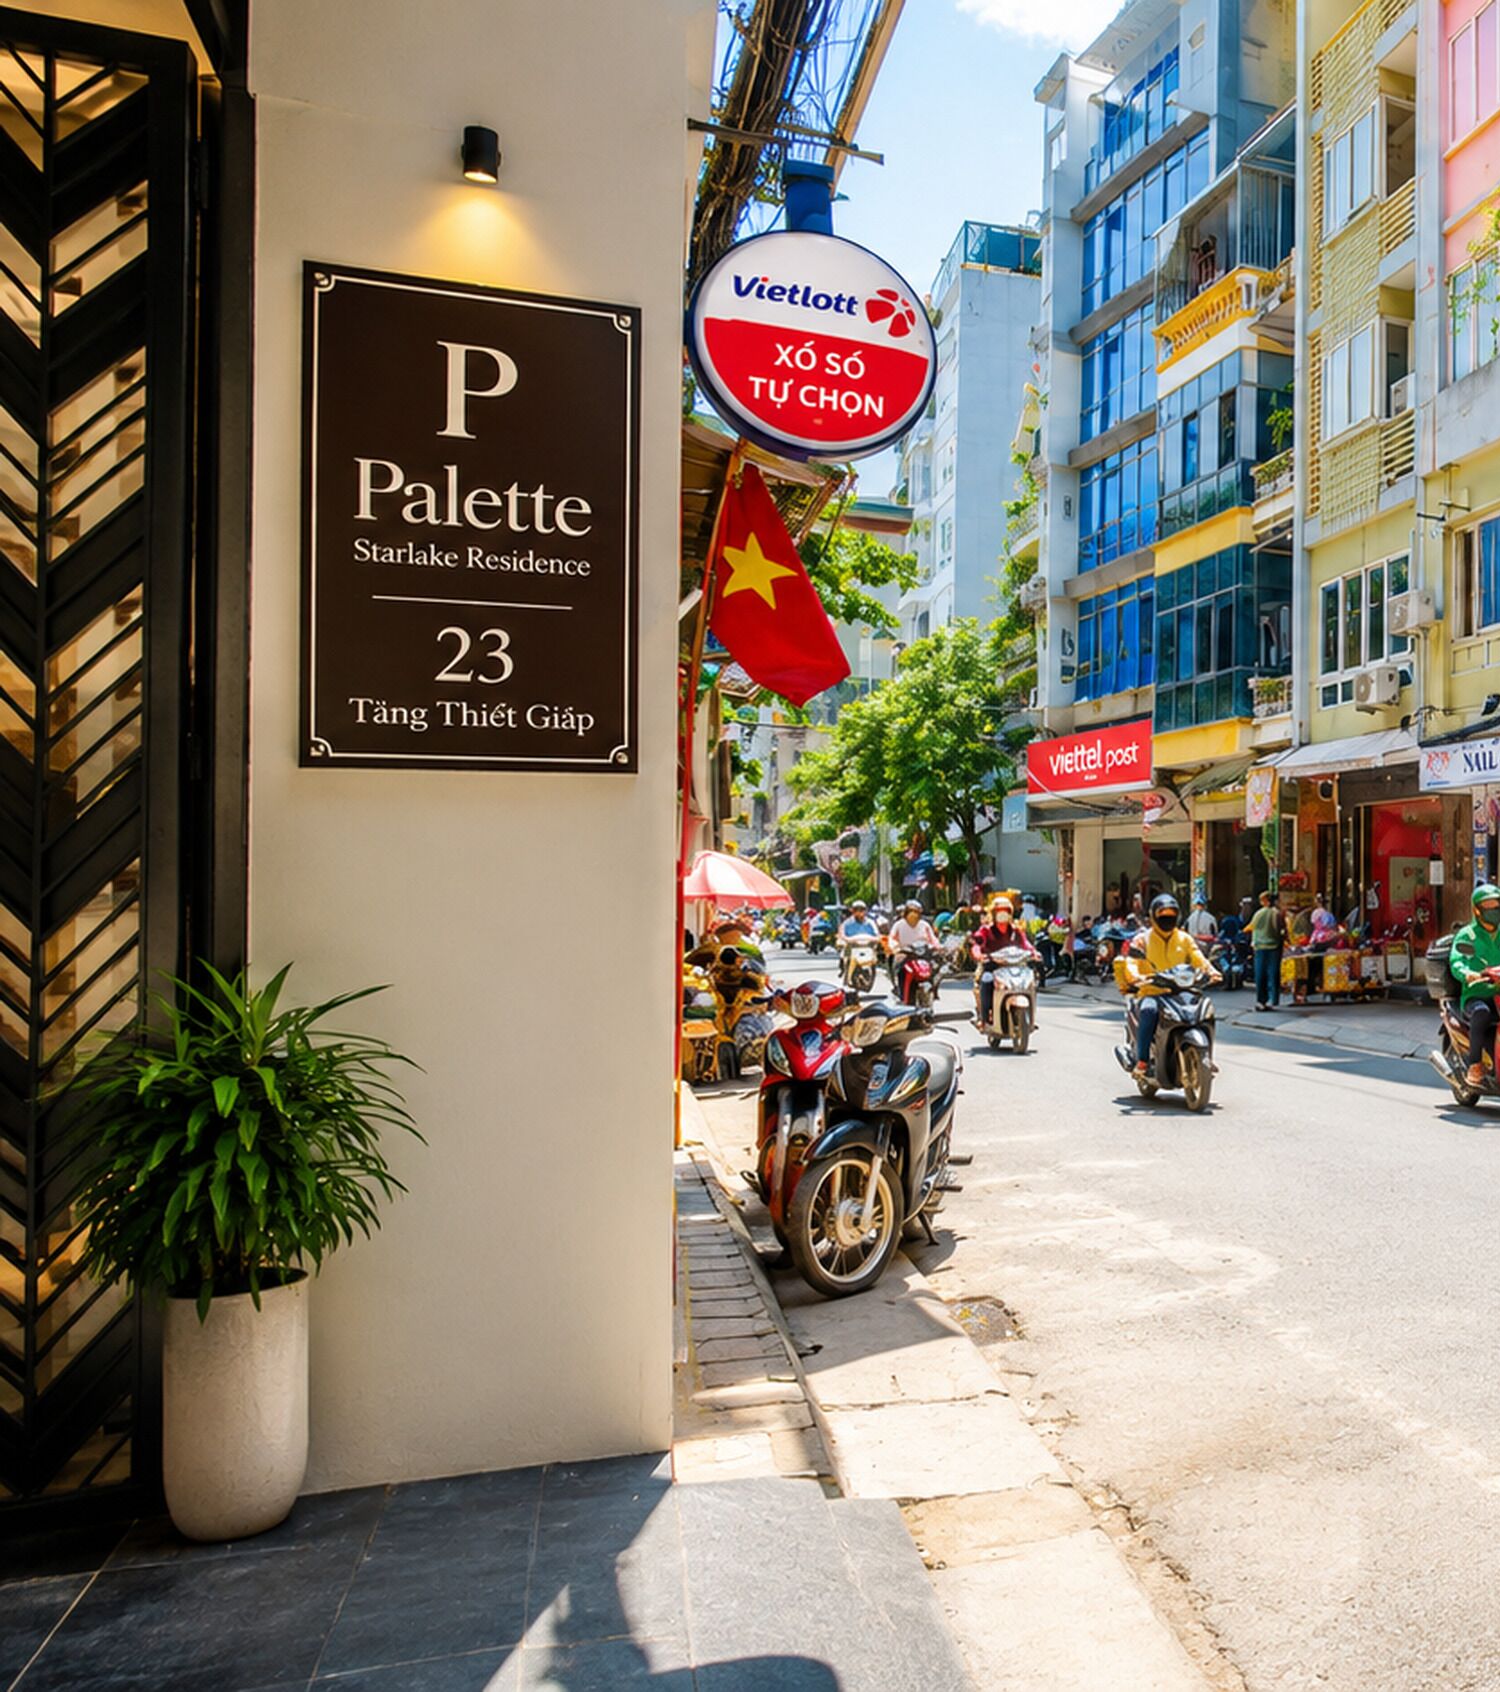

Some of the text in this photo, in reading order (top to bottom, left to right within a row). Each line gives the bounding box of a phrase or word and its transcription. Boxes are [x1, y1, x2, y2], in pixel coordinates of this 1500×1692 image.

[733, 275, 859, 316] Vietlott
[437, 340, 519, 440] P
[748, 375, 884, 418] TỰ CHỌN
[354, 457, 592, 537] Palette
[354, 537, 592, 577] Starlake Residence
[434, 626, 515, 684] 23
[1049, 738, 1140, 776] viettel post
